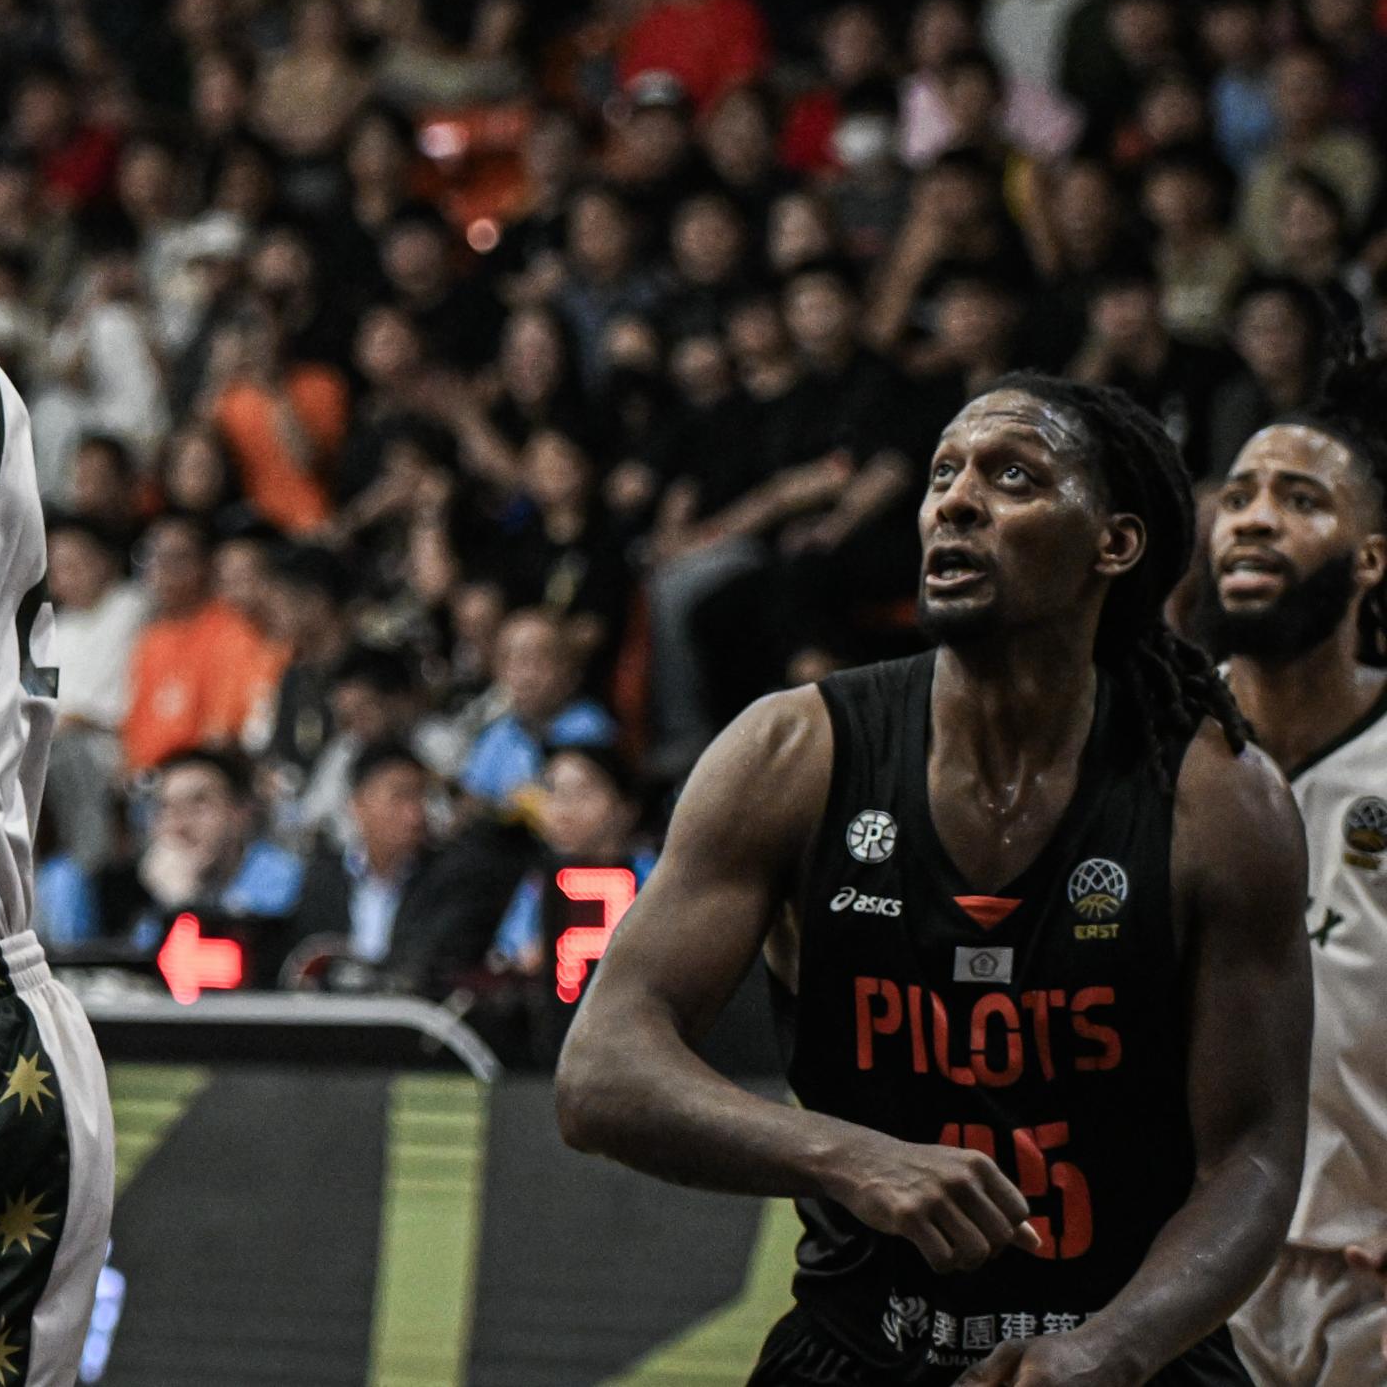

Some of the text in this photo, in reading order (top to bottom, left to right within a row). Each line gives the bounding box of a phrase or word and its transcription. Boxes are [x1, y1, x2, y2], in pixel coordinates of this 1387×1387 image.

[852, 894, 903, 917] asics
[1074, 923, 1120, 940] EAST
[855, 976, 1122, 1087] PILOTS
